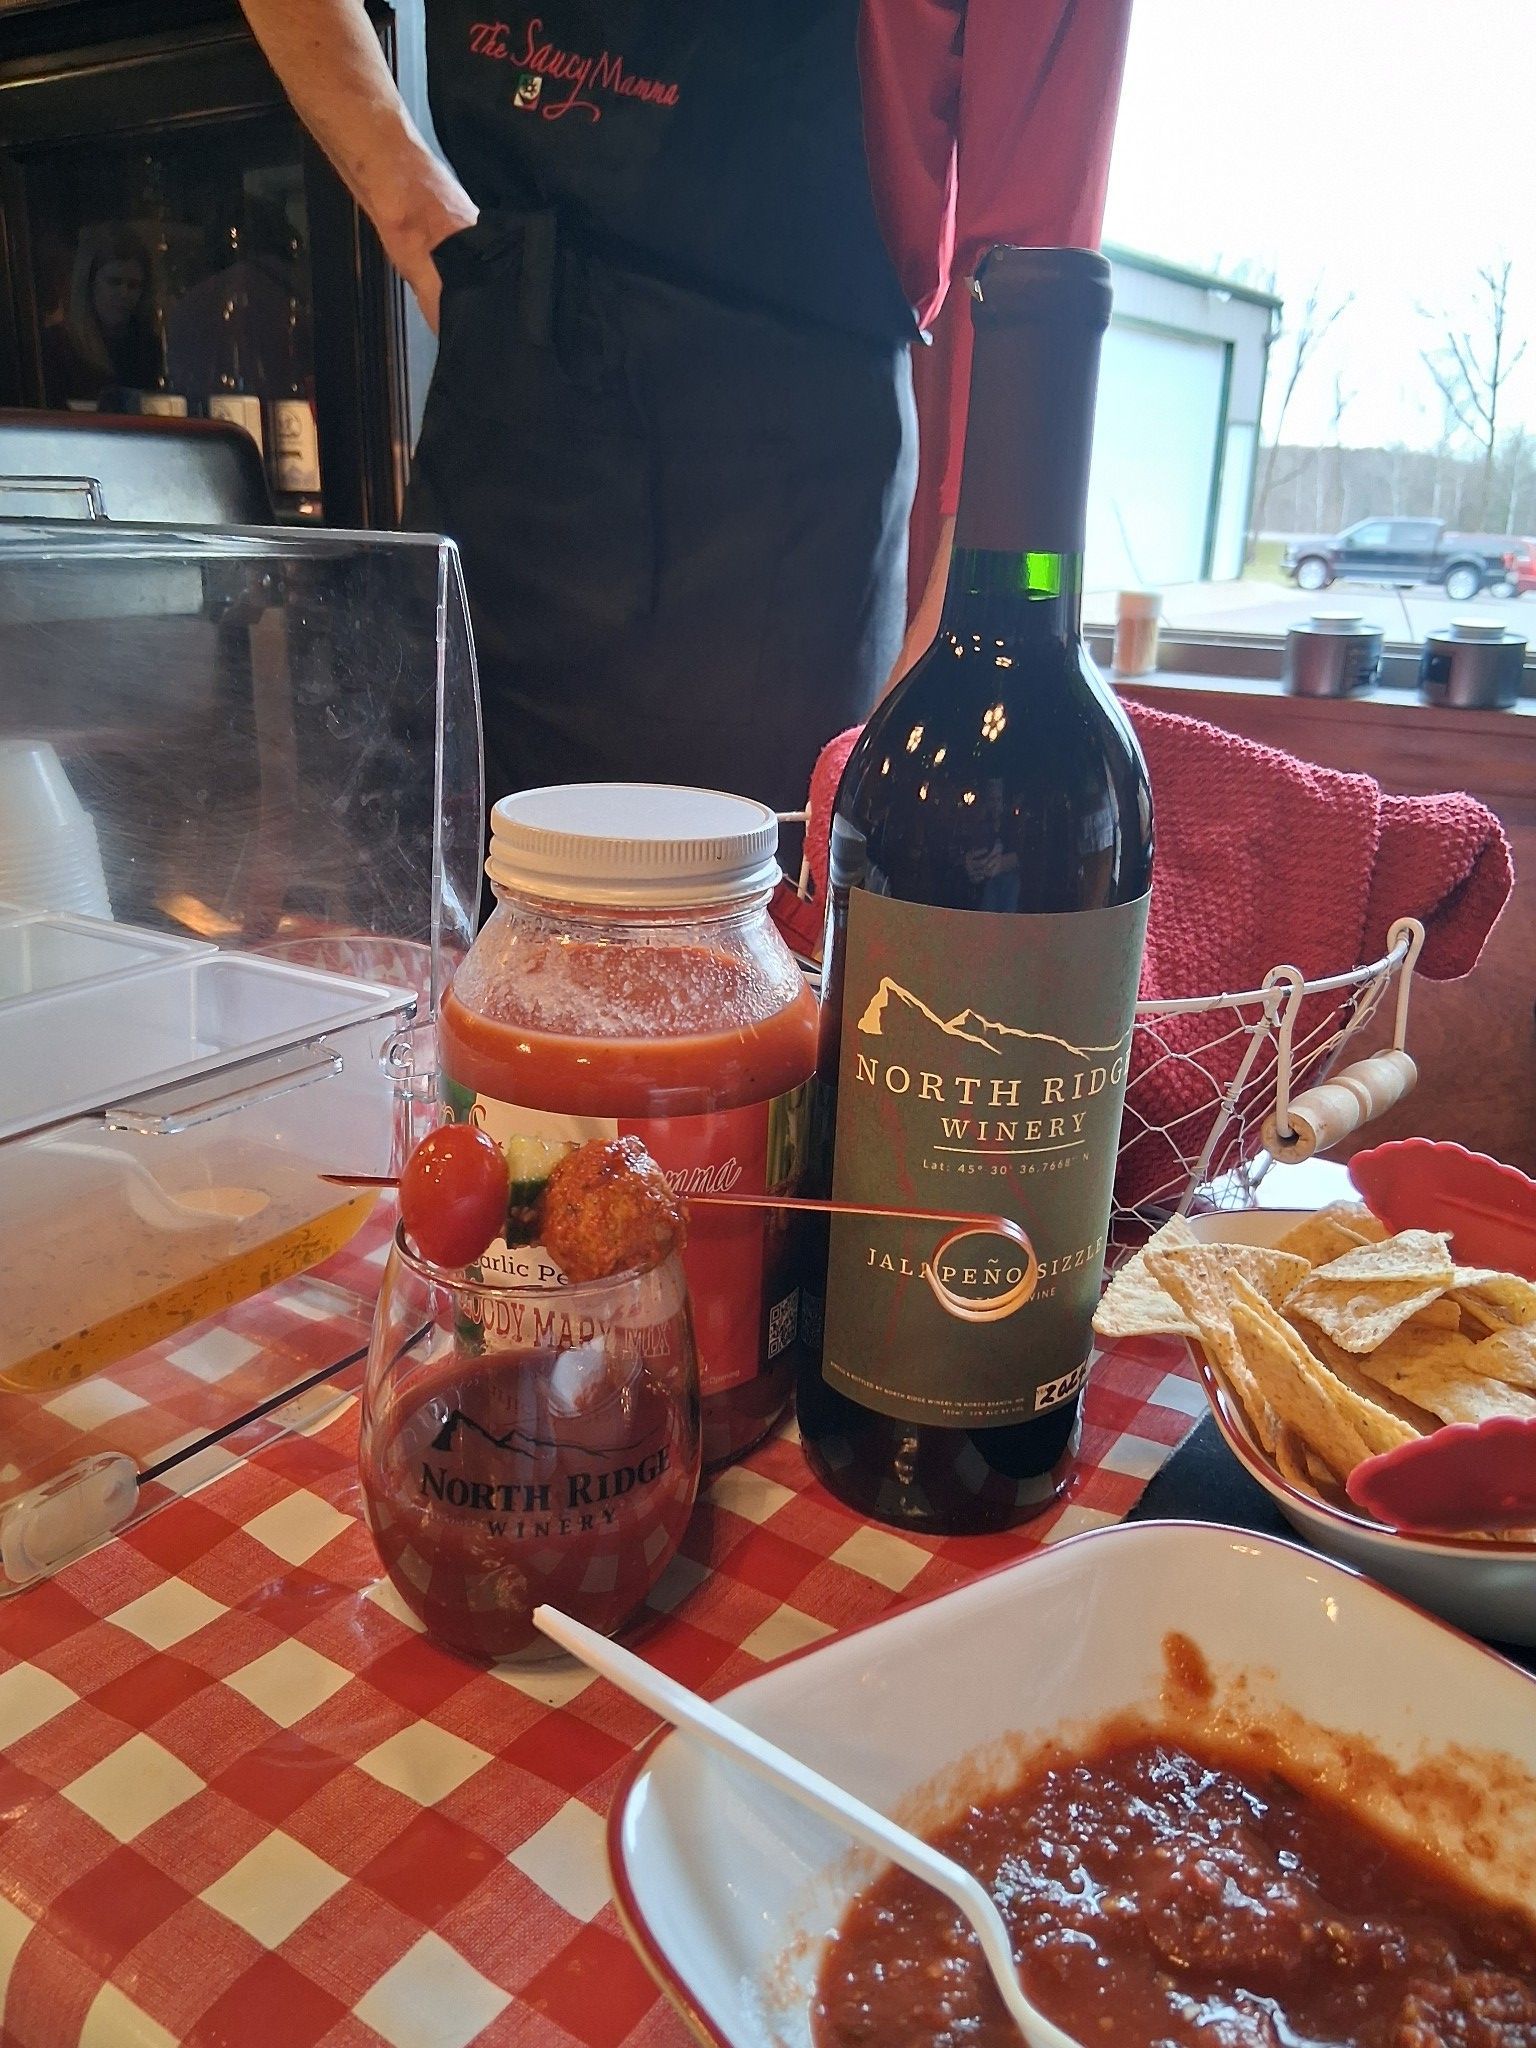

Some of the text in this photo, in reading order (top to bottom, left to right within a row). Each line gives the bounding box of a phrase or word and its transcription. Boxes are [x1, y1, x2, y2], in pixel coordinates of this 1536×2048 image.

[469, 18, 680, 122] The Saucy Mamma
[856, 1053, 1022, 1106] NORTH
[941, 1111, 1087, 1141] WINERY
[664, 1157, 742, 1193] mma
[923, 1158, 950, 1172] Lat:
[472, 1253, 529, 1278] arlic
[1037, 1236, 1103, 1280] SIZZLE
[420, 1445, 670, 1512] NORTH RIDGE
[488, 1507, 616, 1539] WINERY
